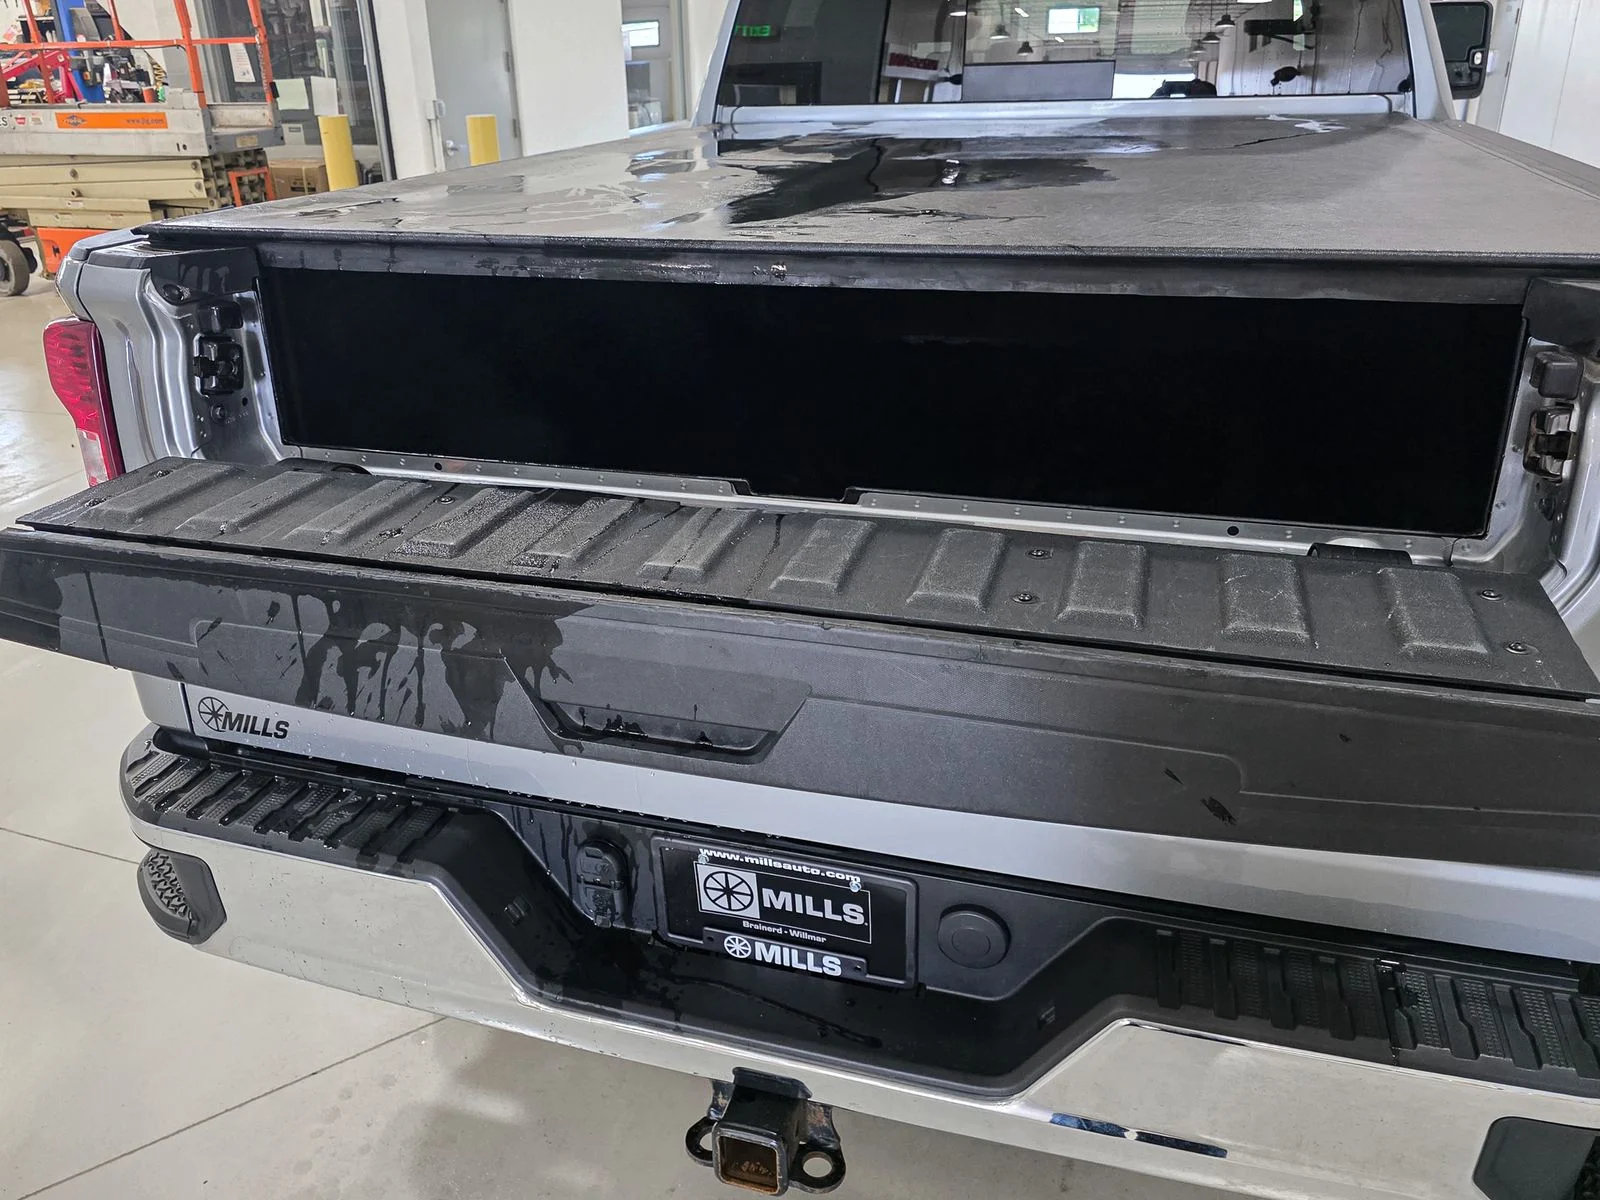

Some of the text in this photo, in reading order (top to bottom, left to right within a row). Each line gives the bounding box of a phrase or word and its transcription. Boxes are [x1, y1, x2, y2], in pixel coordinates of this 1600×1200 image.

[221, 711, 290, 739] MILLS
[699, 848, 861, 883] www.millsauto.com
[761, 887, 866, 926] MILLS
[742, 920, 783, 935] Brainerd
[789, 929, 827, 943] Willmar
[754, 941, 843, 977] MILLS
